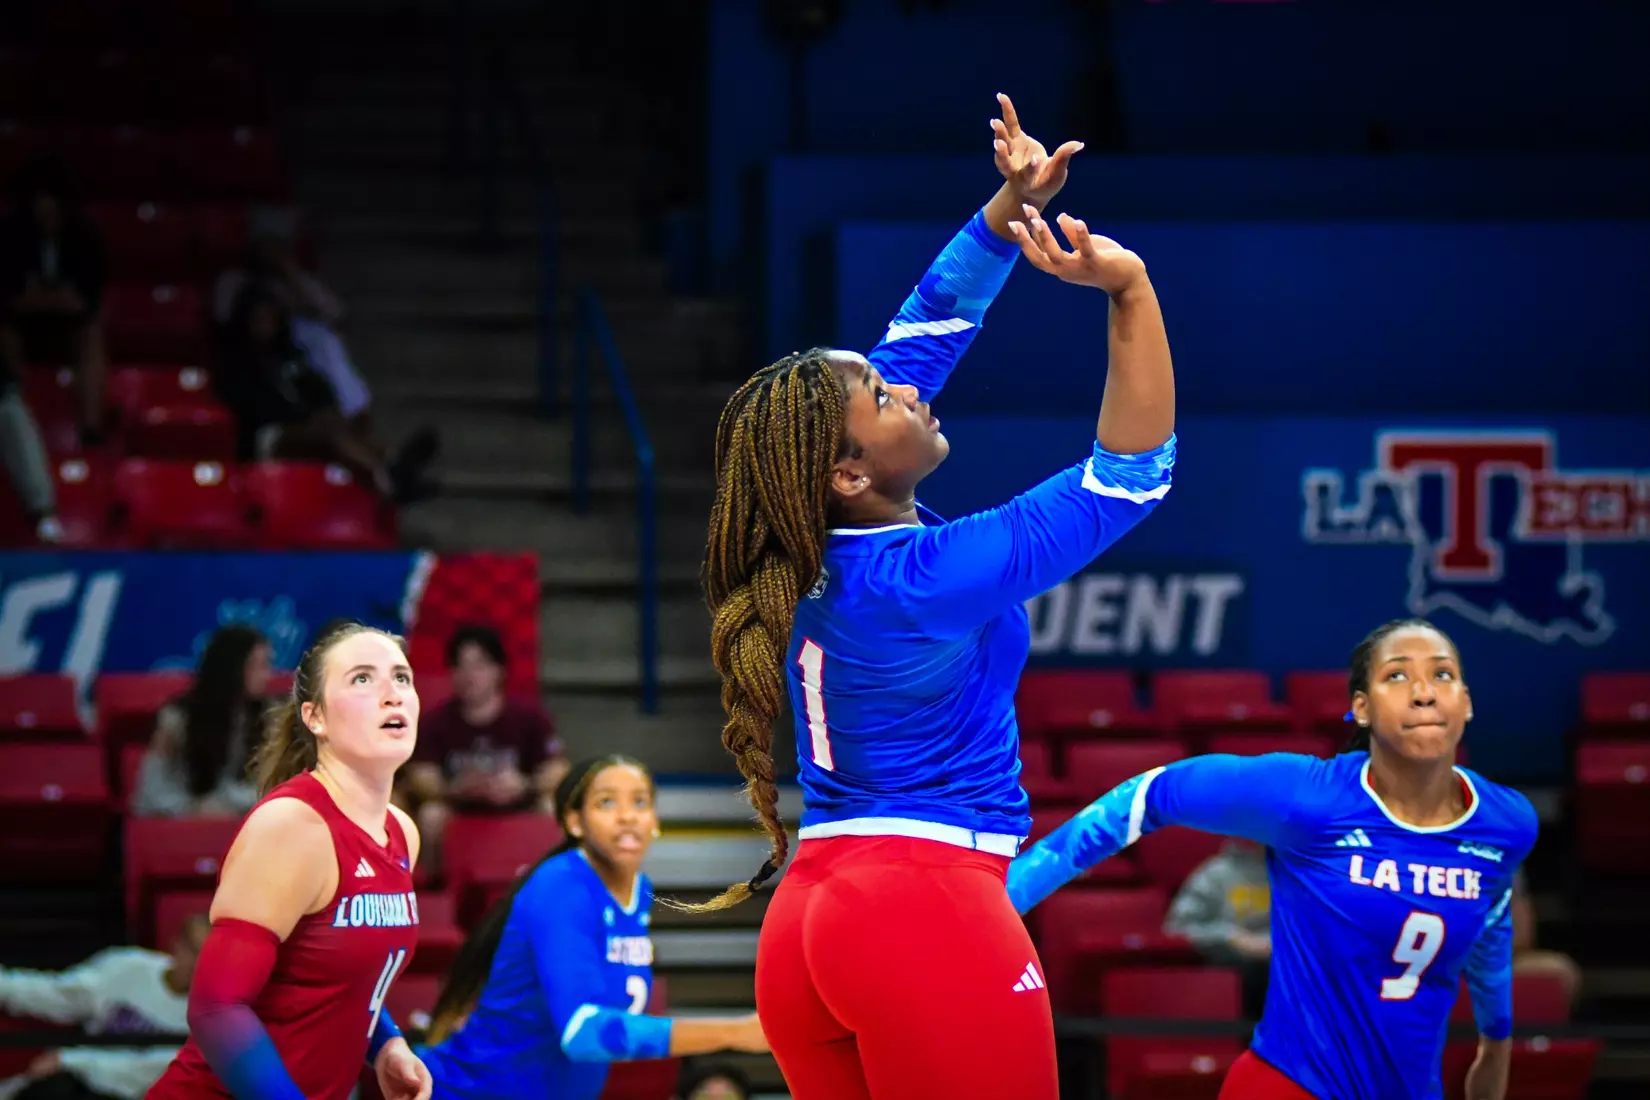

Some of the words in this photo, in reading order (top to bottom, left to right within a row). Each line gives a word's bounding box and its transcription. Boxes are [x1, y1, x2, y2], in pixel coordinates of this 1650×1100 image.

[1303, 468, 1414, 542] LA
[798, 637, 835, 771] 1
[1349, 854, 1401, 892] LA
[1407, 862, 1482, 899] TECH
[367, 947, 406, 1038] 4
[1380, 910, 1445, 1001] 9
